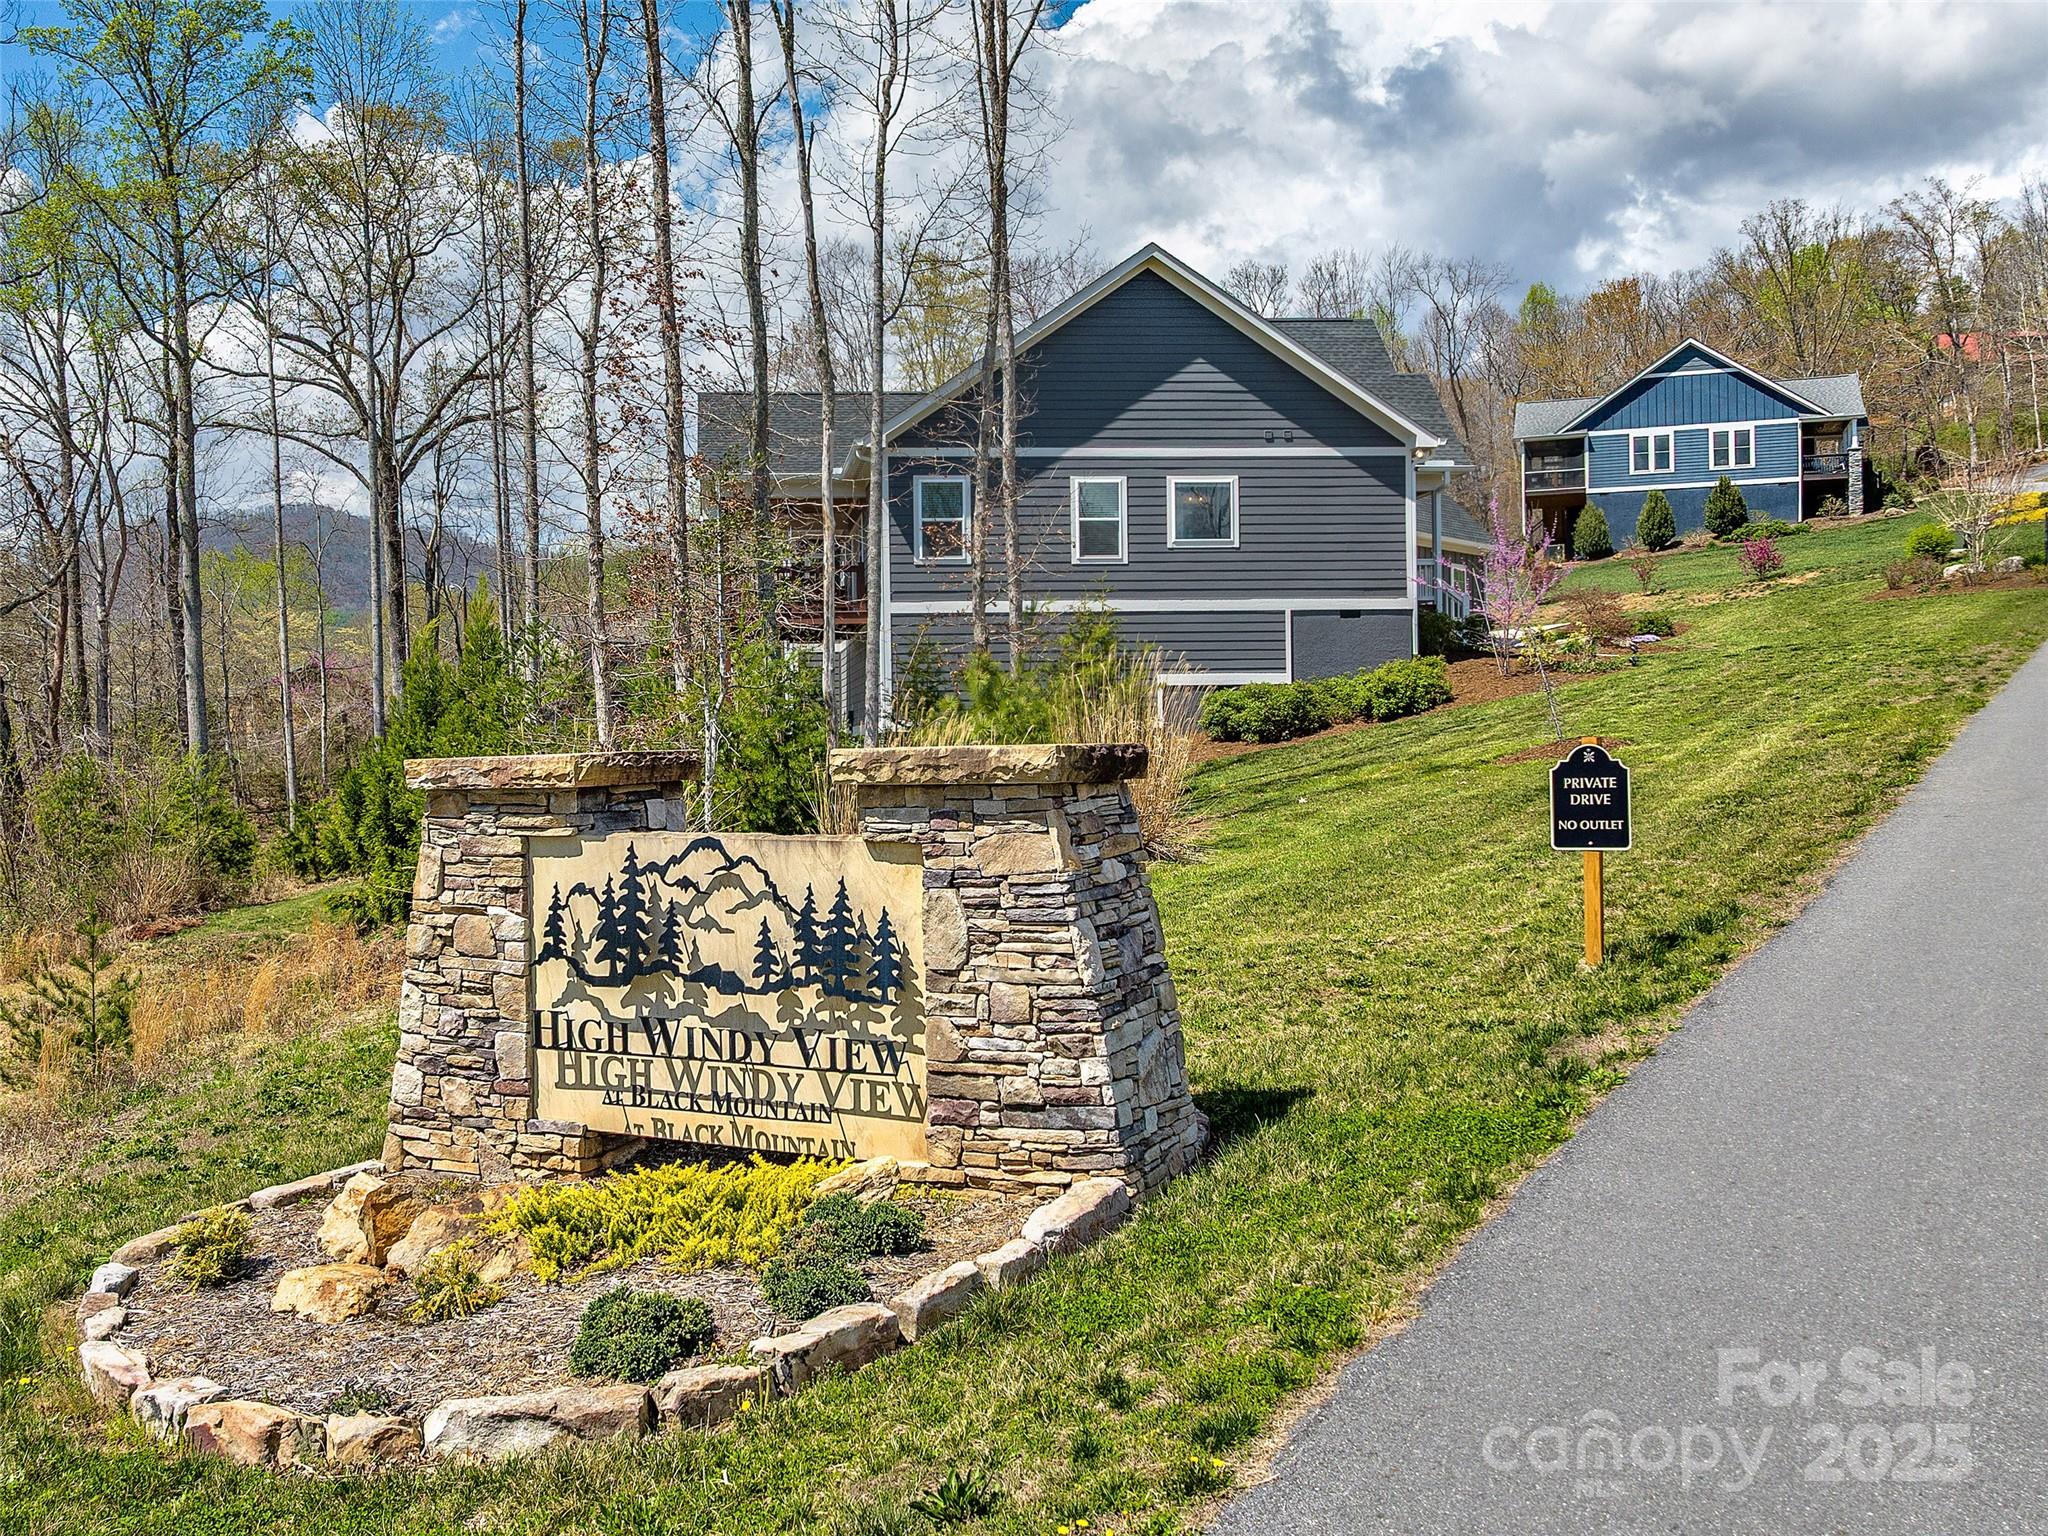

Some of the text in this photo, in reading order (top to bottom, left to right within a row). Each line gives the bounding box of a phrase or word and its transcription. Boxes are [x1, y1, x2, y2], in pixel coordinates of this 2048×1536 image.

[1563, 777, 1617, 789] PRIVATE
[1570, 794, 1611, 806] DRIVE
[1558, 820, 1624, 830] NO OUTLET
[533, 1010, 908, 1077] HIGH WINDY VIEW
[631, 1085, 703, 1113] BLACK
[711, 1090, 832, 1124] MOUNTAIN
